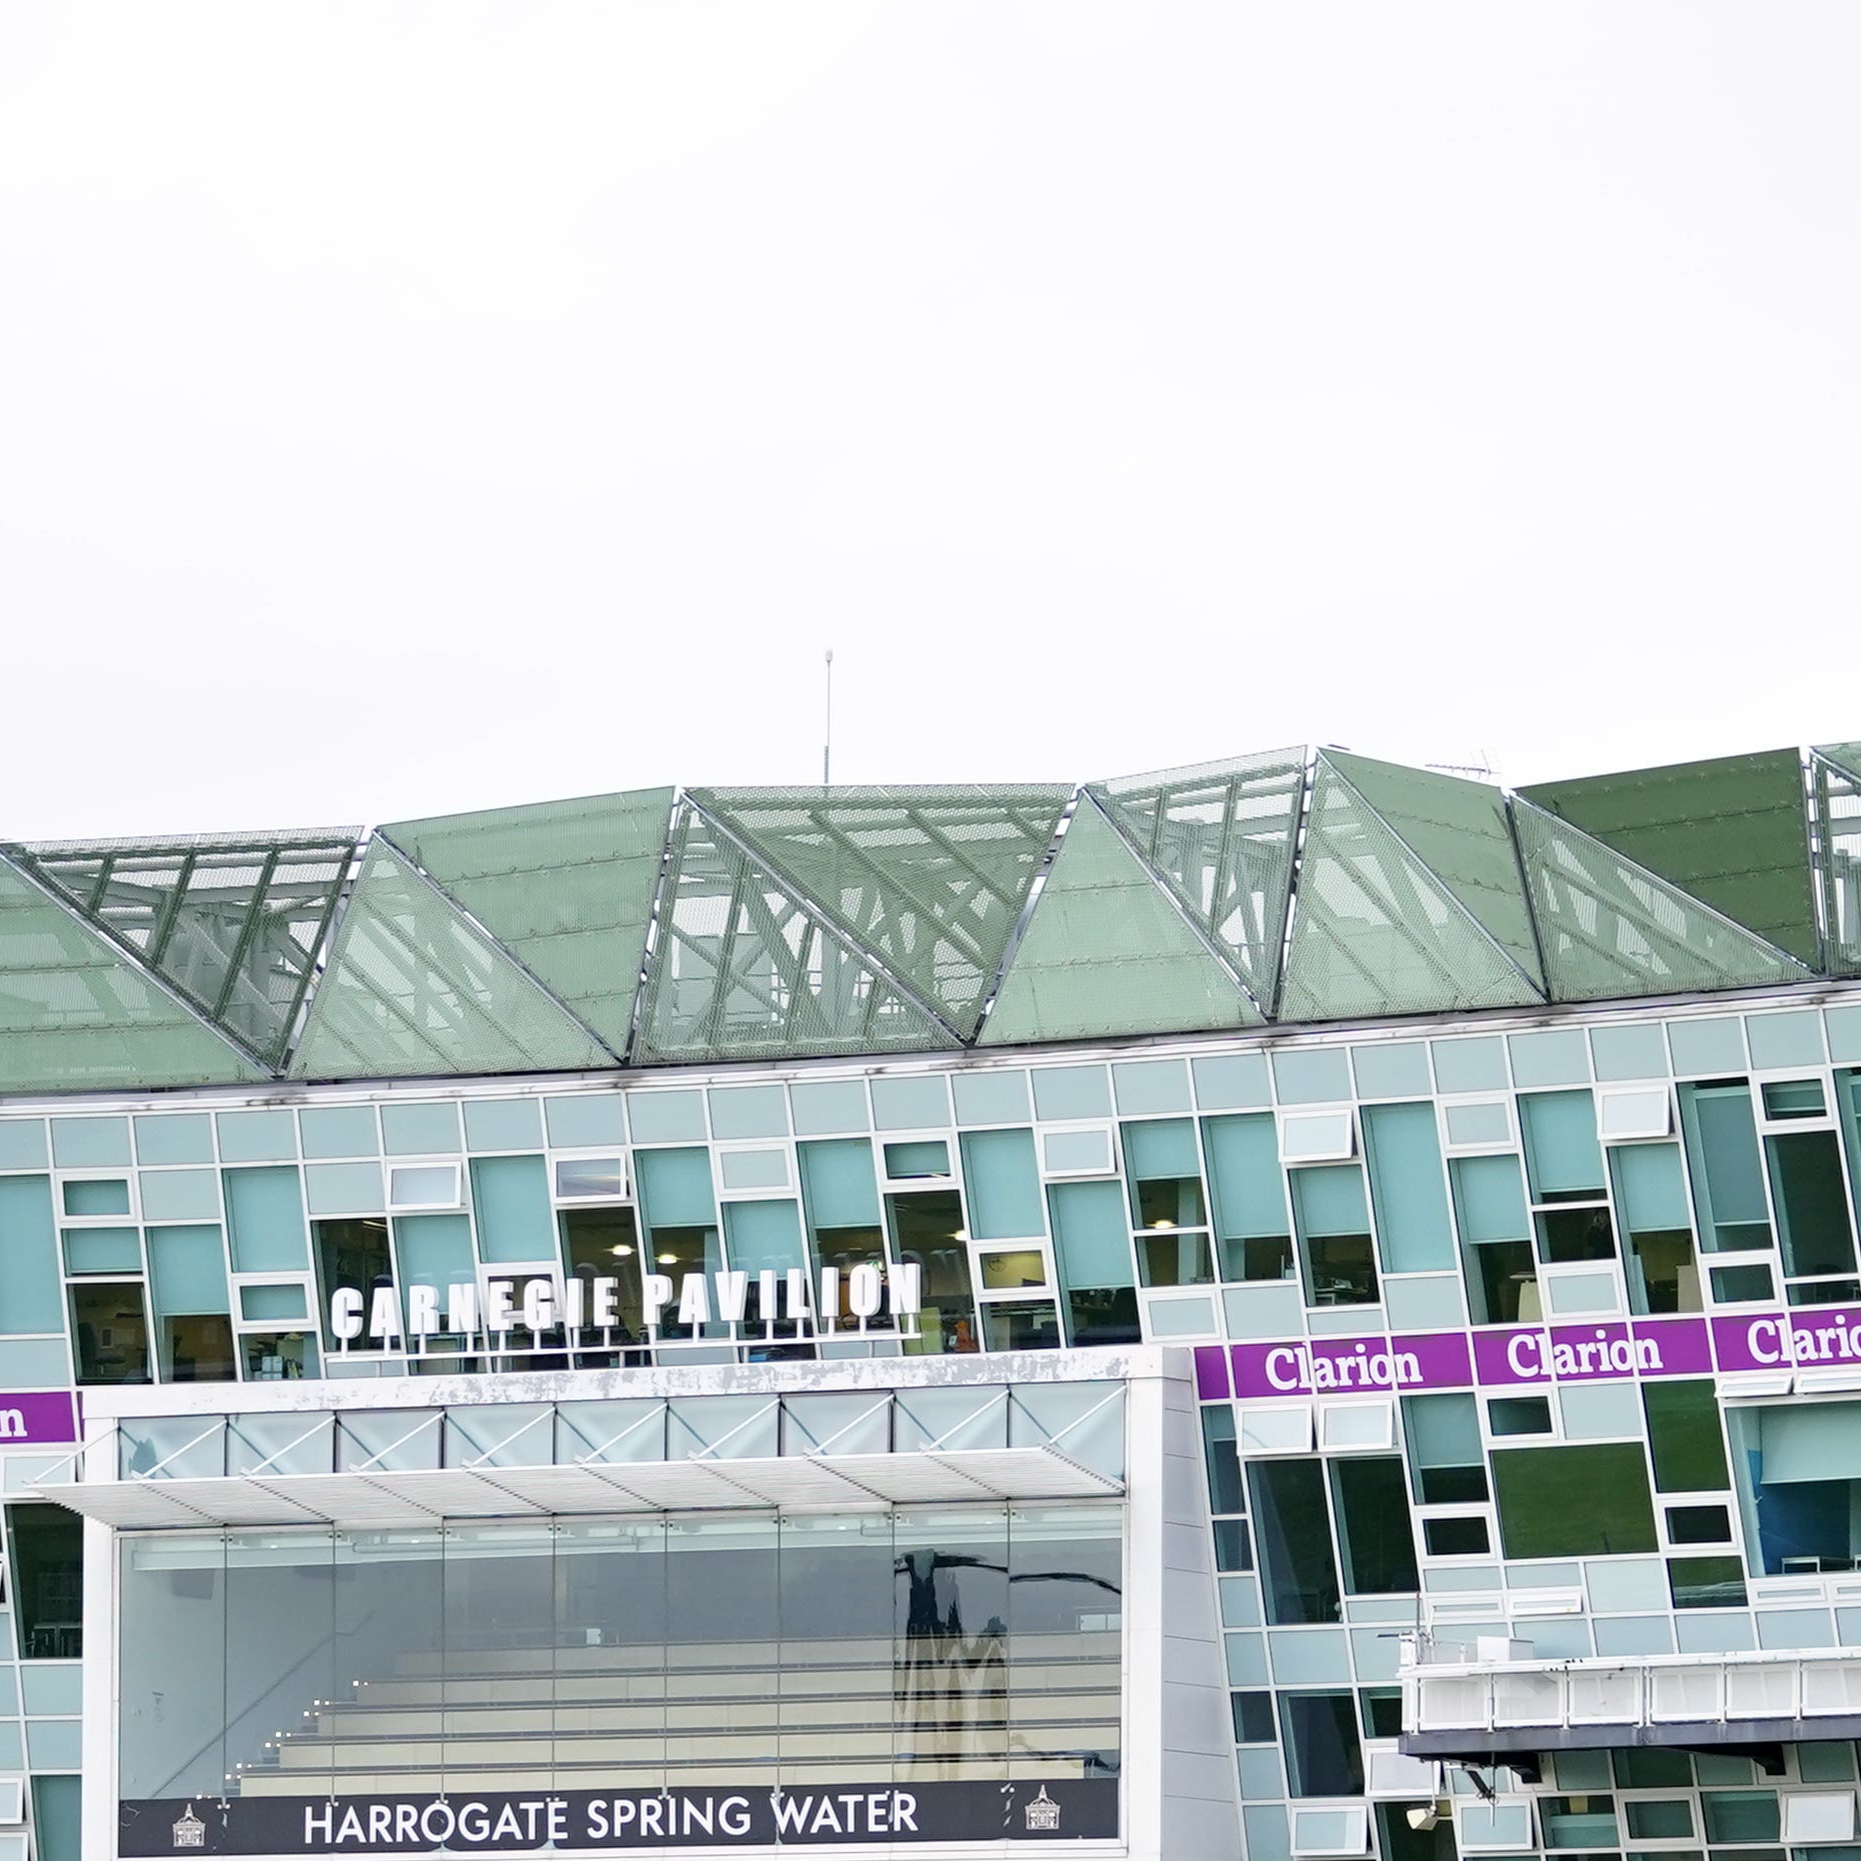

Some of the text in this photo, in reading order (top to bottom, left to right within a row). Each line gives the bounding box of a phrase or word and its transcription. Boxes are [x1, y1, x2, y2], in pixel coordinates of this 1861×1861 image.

[332, 1263, 922, 1340] CARNEGIE PAVILION
[1265, 1343, 1423, 1392] Clarion
[1506, 1329, 1663, 1378] Clarion
[304, 1793, 918, 1844] HARROGATE SPRING WATER
